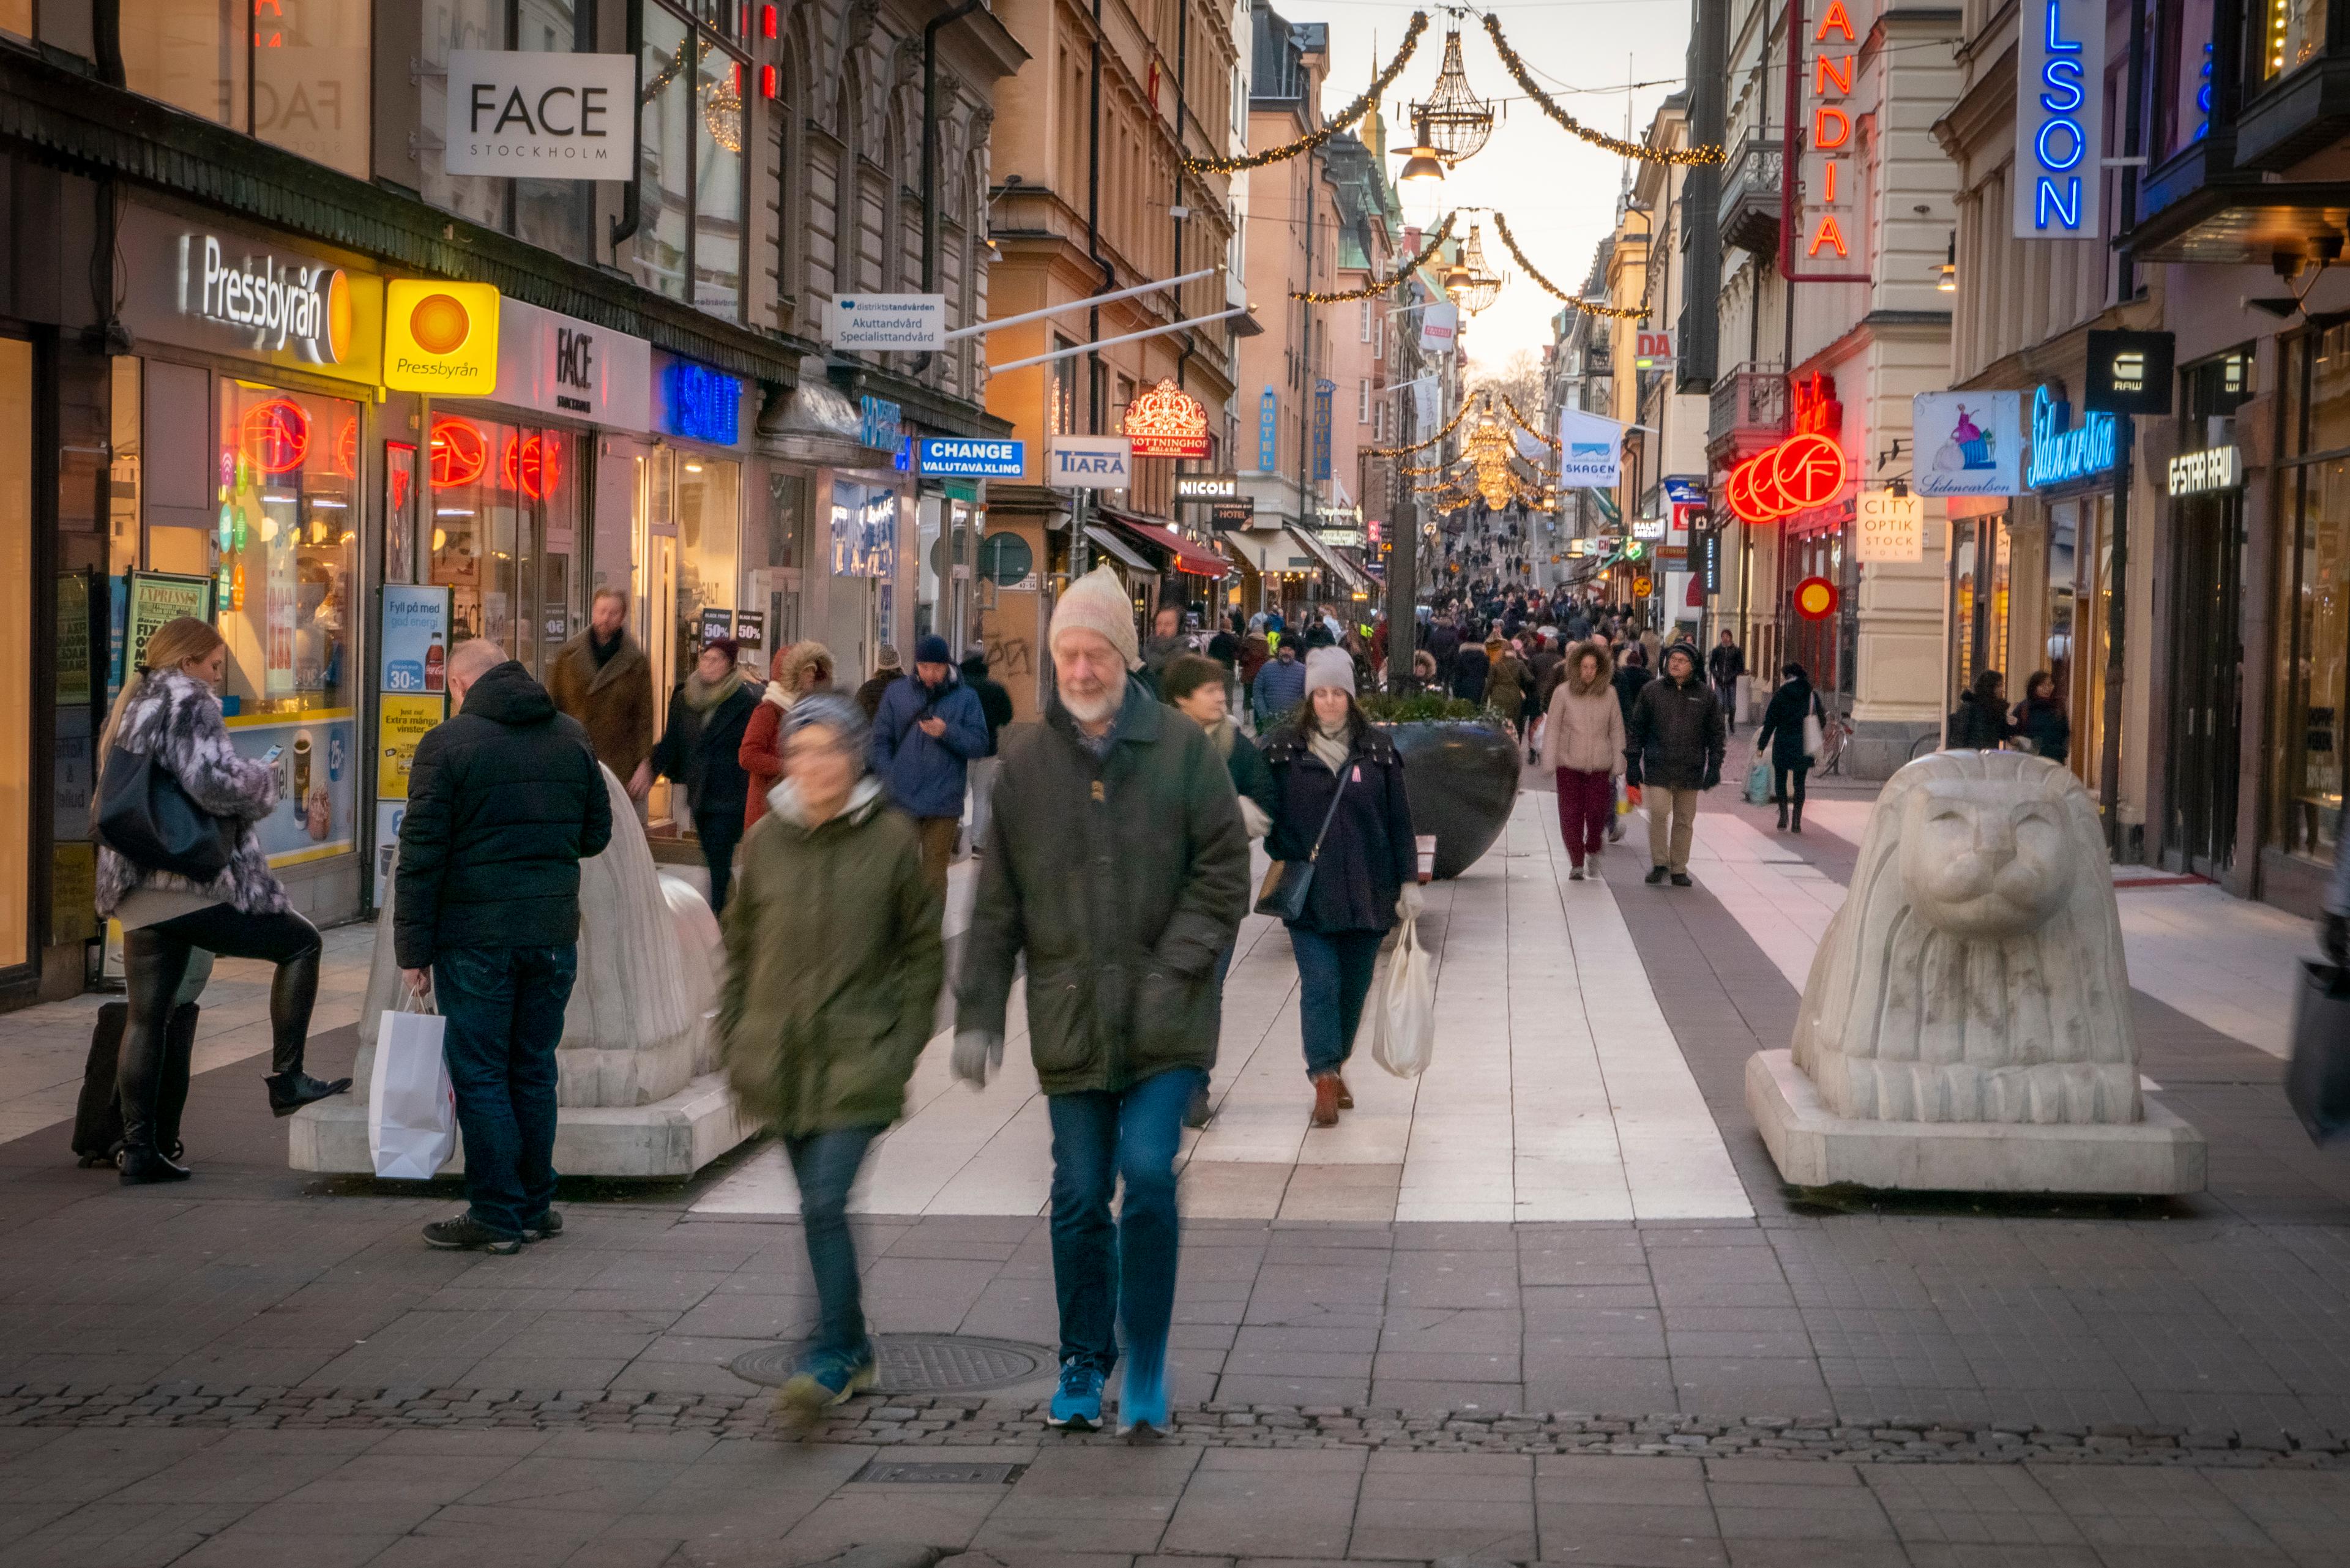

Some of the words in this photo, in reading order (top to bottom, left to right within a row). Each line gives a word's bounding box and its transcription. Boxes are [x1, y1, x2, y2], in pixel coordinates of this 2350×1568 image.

[471, 84, 608, 136] FACE
[470, 144, 608, 160] STOCKHOLM
[203, 235, 321, 351] Pressbyrån
[857, 301, 935, 312] distriktstandvården
[852, 318, 922, 329] Akuttandvård
[840, 331, 934, 343] Specialisttandvård
[556, 326, 592, 389] FACE
[396, 357, 479, 379] Pressbyrån
[2114, 381, 2142, 390] RAW
[1263, 398, 1274, 466] HOTEL
[1315, 398, 1329, 476] HOTEL
[1132, 437, 1209, 449] ROTTNINGHOF
[931, 442, 1013, 460] CHANGE
[1054, 450, 1125, 475] TIARA
[1566, 464, 1615, 474] SKAGEN
[2207, 445, 2232, 489] RAW
[1180, 481, 1234, 495] NICOLE
[1919, 468, 2010, 495] Sidencarlson
[1865, 499, 1915, 514] CITY
[1865, 520, 1913, 532] OPTIK
[1866, 536, 1914, 546] STOCK
[390, 602, 405, 614] Fyll
[406, 602, 418, 614] på
[420, 603, 440, 613] med
[704, 623, 729, 638] 50%
[738, 624, 761, 640] 50%
[386, 715, 407, 725] Extra
